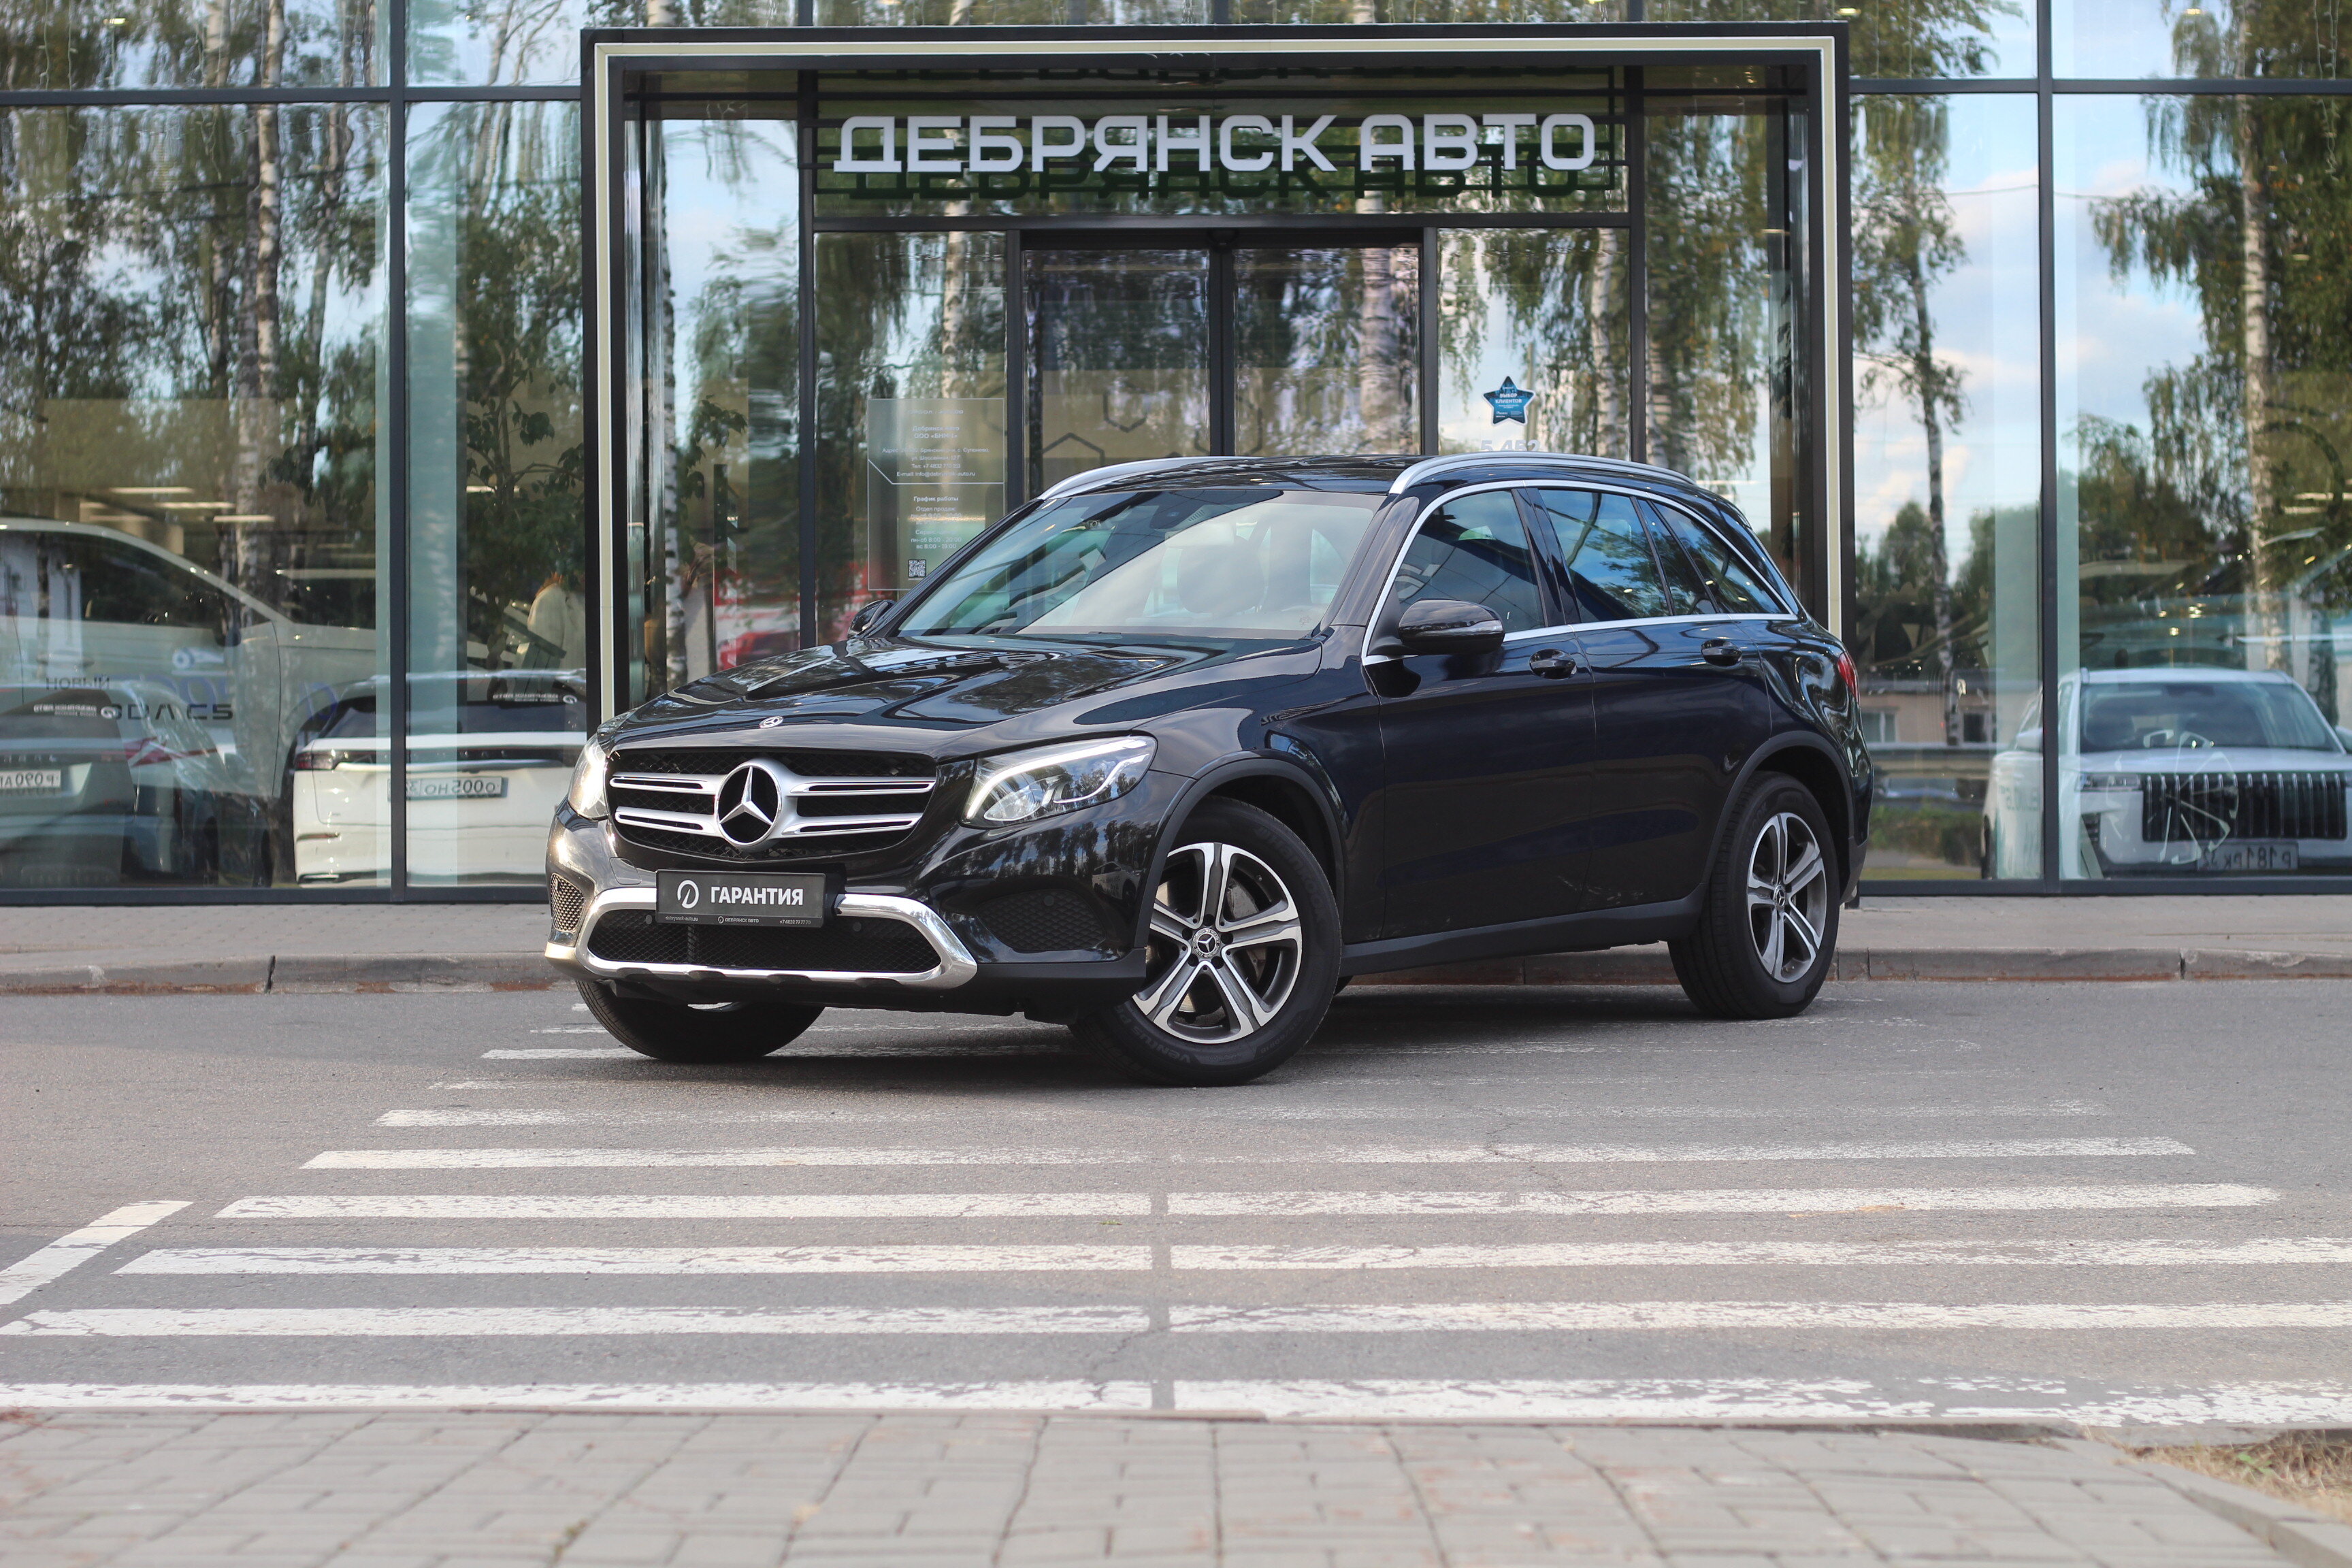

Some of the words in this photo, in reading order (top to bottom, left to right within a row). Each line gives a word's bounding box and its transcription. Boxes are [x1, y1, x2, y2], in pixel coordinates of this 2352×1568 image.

[833, 114, 1337, 173] ДЕБРЯНСК
[1360, 112, 1597, 172] АВТО
[46, 674, 110, 690] НОВЫЙ
[186, 704, 234, 720] C5
[710, 886, 804, 906] ГАРАНТИЯ
